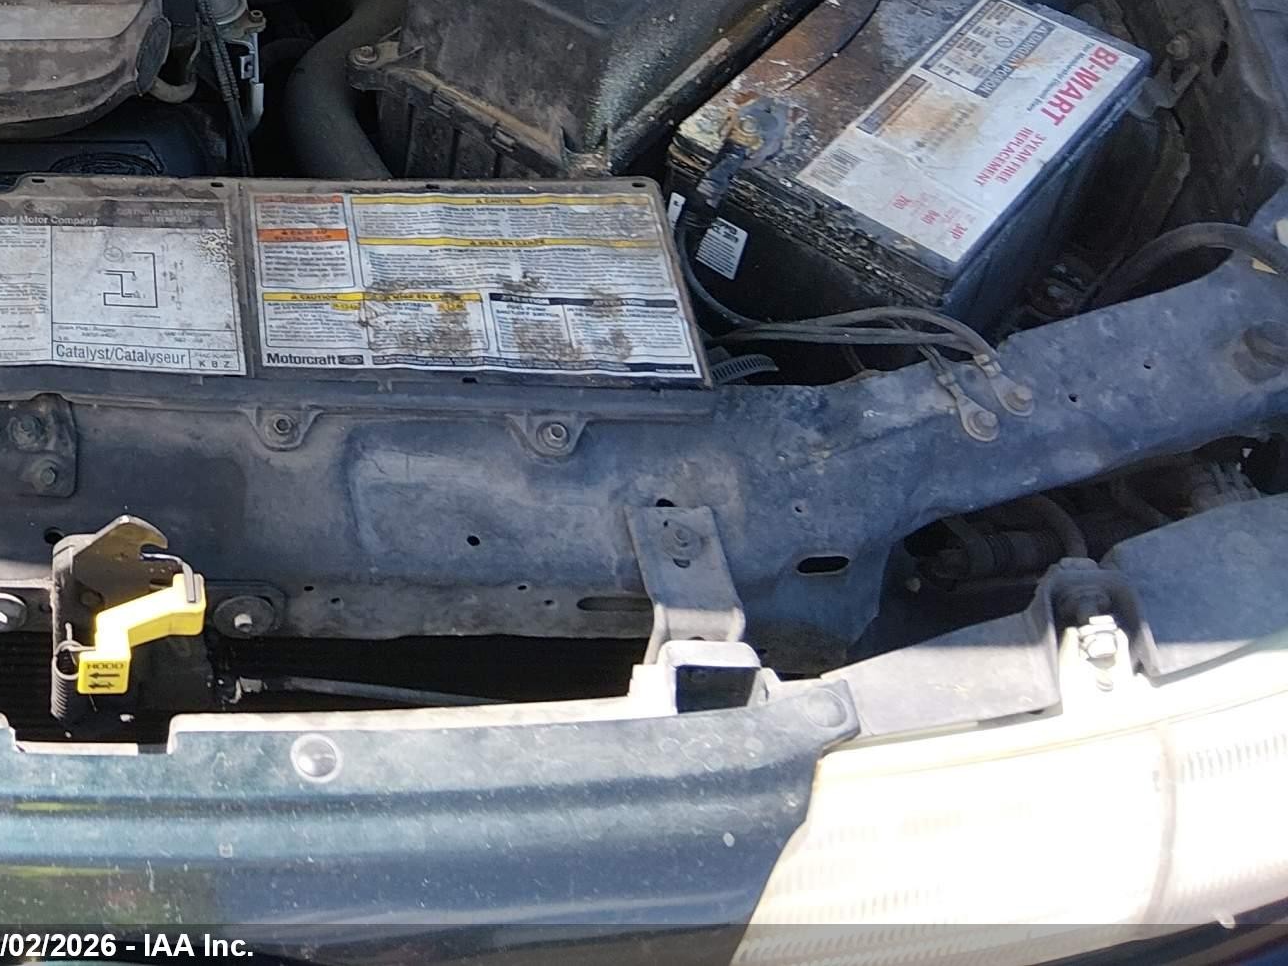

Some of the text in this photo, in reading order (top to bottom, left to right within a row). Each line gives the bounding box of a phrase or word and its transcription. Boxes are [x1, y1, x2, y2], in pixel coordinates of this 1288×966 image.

[1040, 45, 1121, 126] BI-MART
[973, 127, 1034, 186] REPLACEMENT
[19, 216, 49, 225] Motor
[50, 216, 99, 226] Company
[56, 344, 186, 365] Catalyst/Catalyseur
[266, 352, 337, 365] Motorcraft
